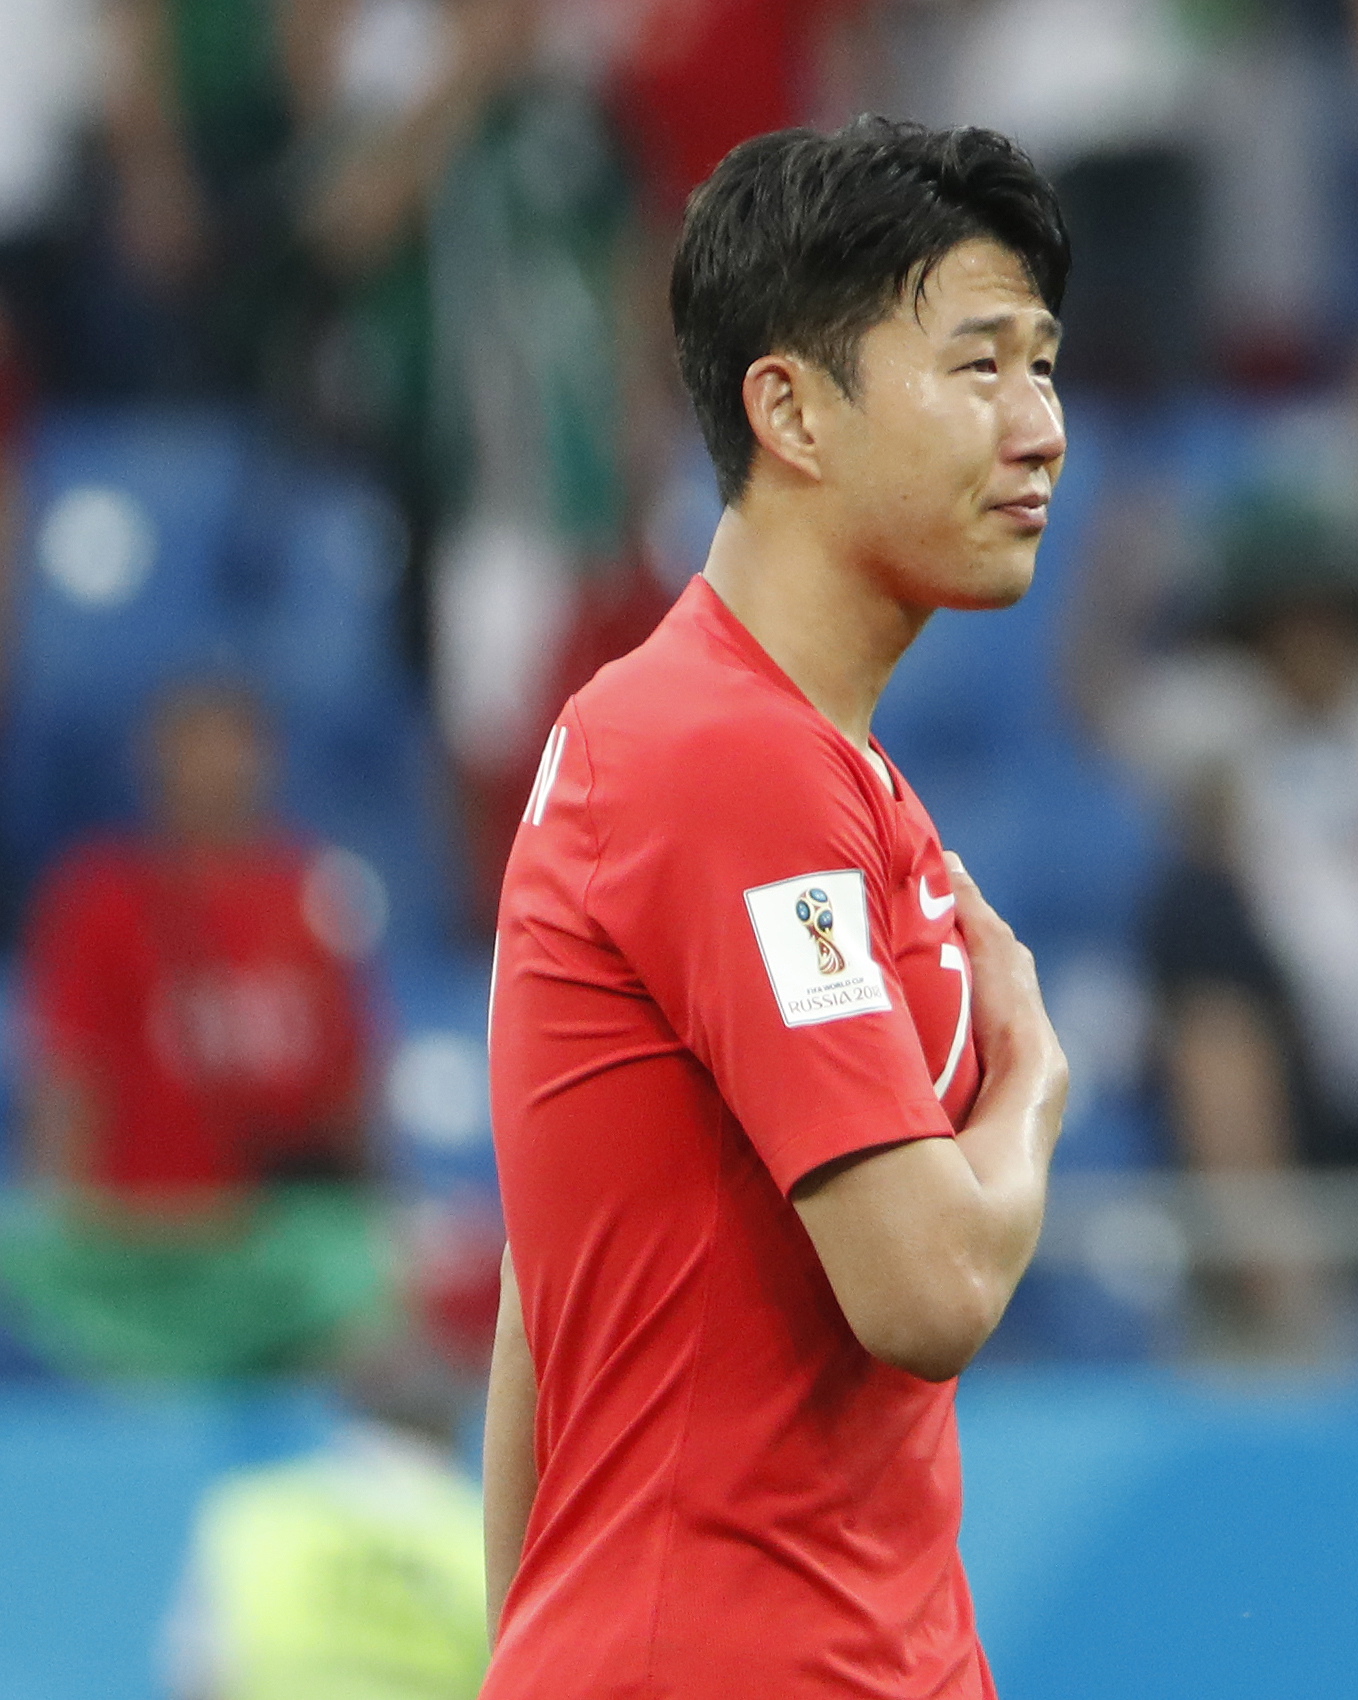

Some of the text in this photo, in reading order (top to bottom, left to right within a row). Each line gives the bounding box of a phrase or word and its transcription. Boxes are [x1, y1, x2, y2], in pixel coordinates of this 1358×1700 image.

[806, 986, 823, 995] FIFA
[824, 980, 851, 991] WORLD
[788, 991, 852, 1013] RUSSIA
